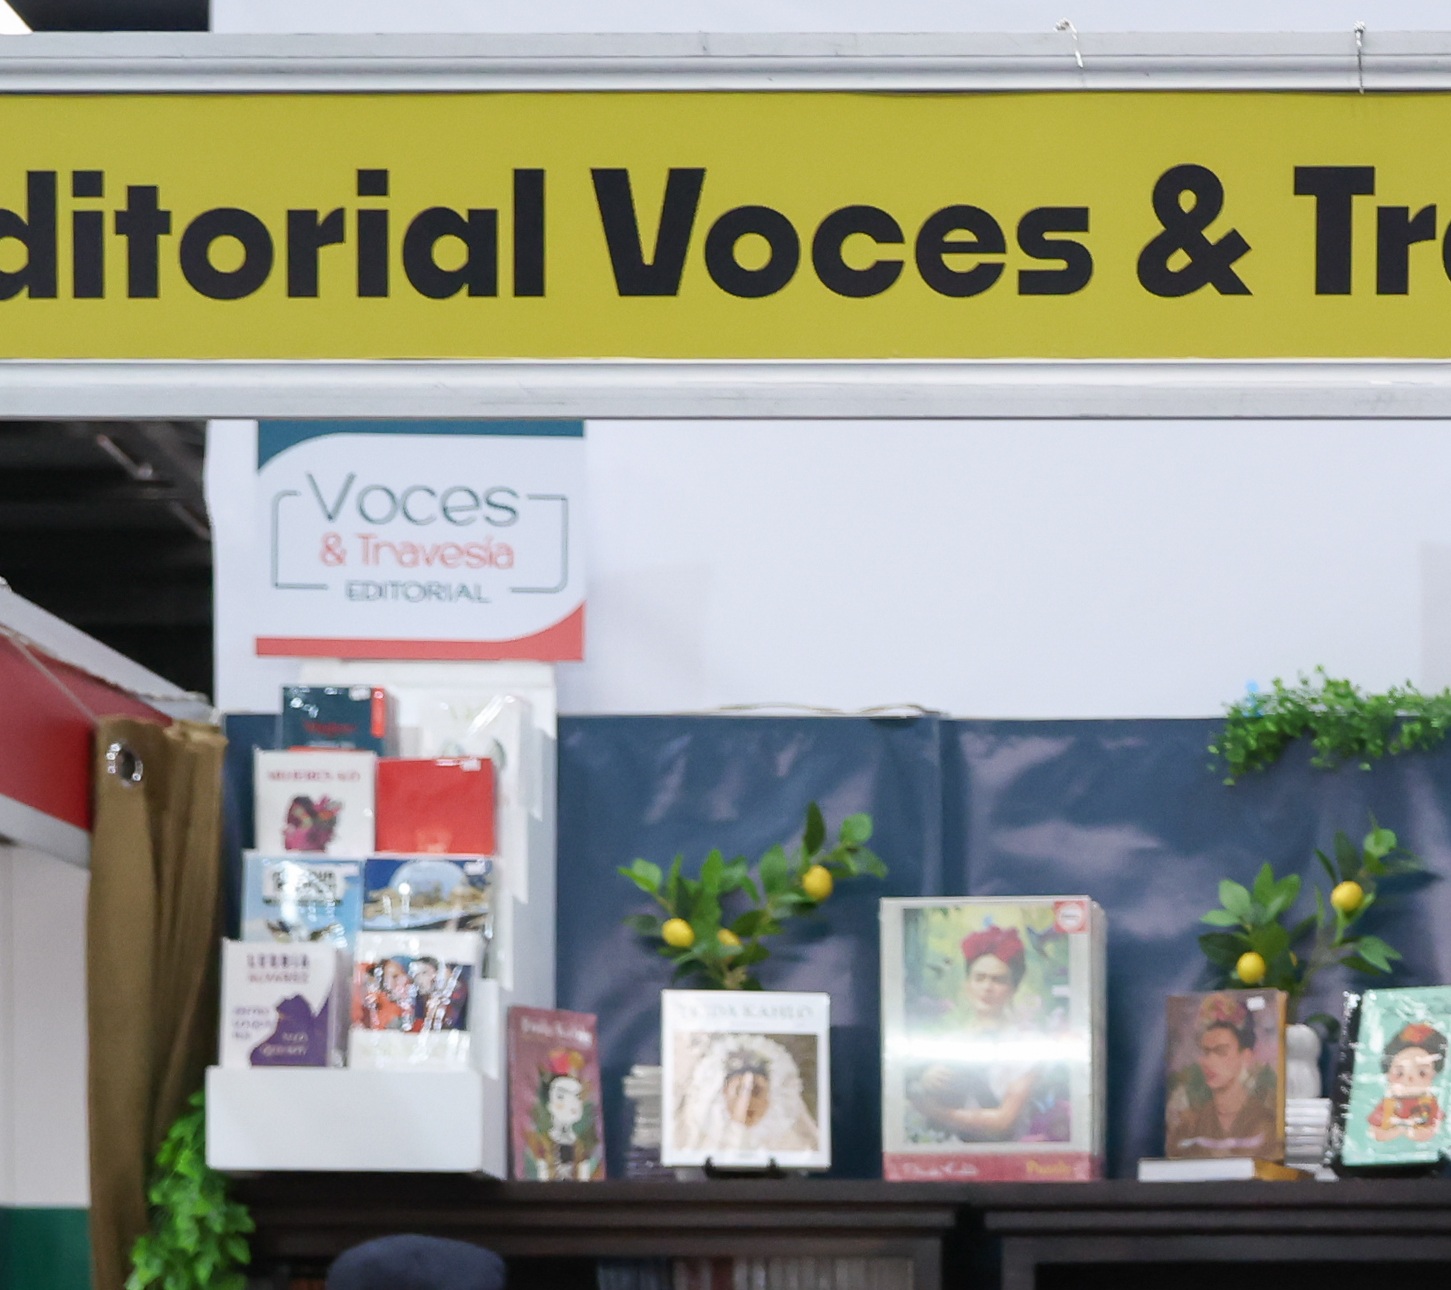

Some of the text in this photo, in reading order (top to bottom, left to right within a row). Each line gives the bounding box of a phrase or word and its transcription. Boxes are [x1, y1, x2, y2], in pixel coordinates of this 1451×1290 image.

[590, 166, 1092, 297] Voces
[1136, 162, 1252, 297] &
[307, 472, 520, 527] Voces
[320, 534, 515, 569] & Travesía
[345, 580, 491, 603] EDITORIAL
